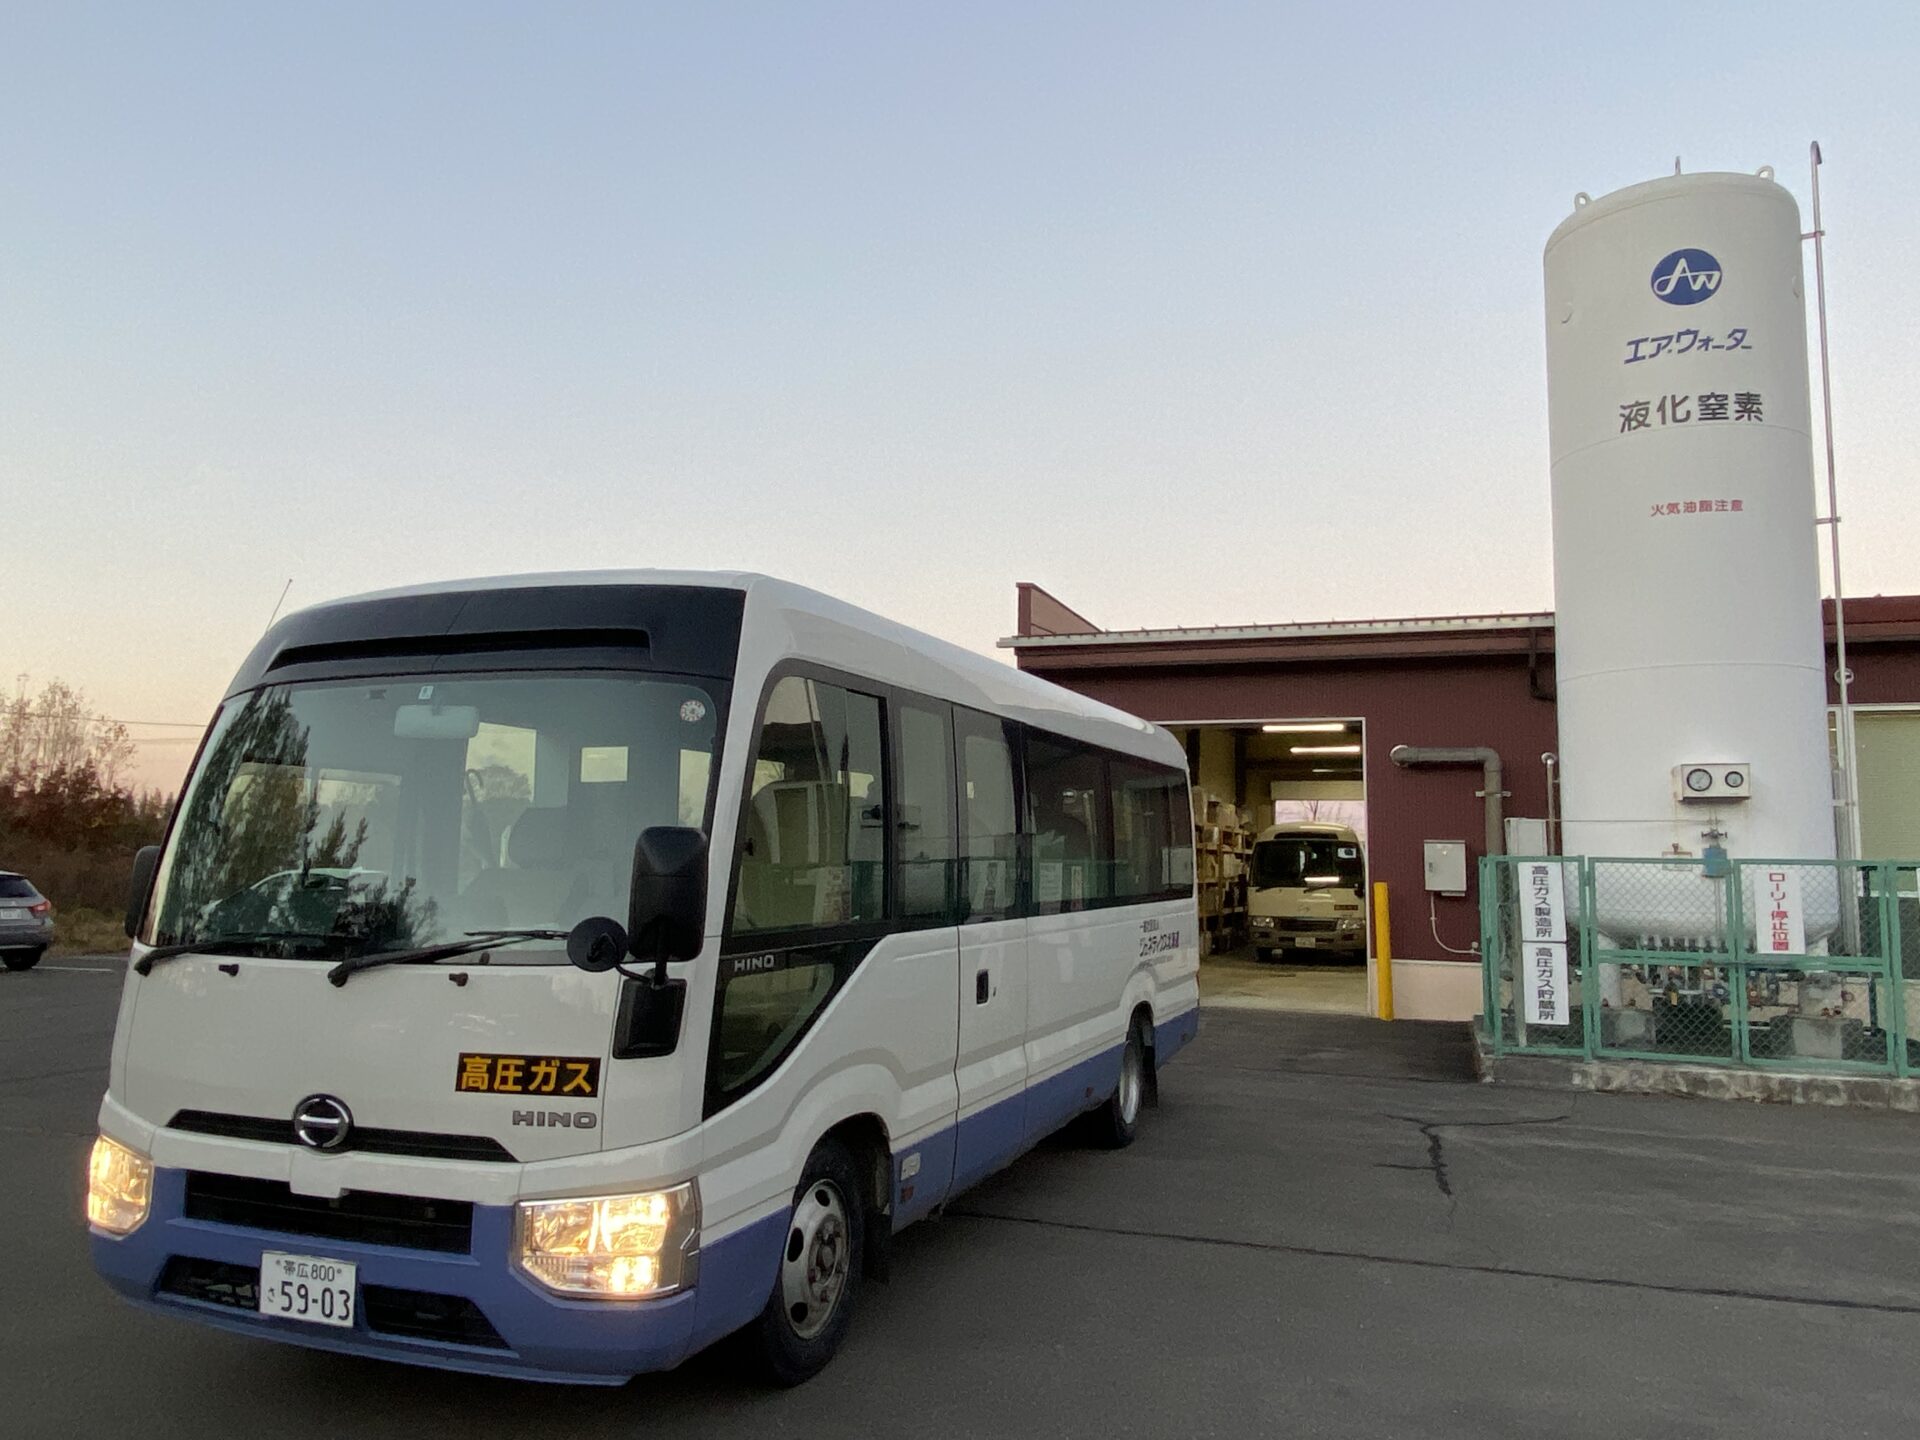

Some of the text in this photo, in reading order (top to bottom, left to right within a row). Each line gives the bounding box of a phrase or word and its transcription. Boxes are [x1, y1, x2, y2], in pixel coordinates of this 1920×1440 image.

[1619, 391, 1763, 433] 液化窒素
[734, 954, 774, 972] HINO
[461, 1056, 592, 1093] 高圧ガス
[512, 1110, 597, 1129] HINO
[281, 1281, 350, 1320] 59-03
